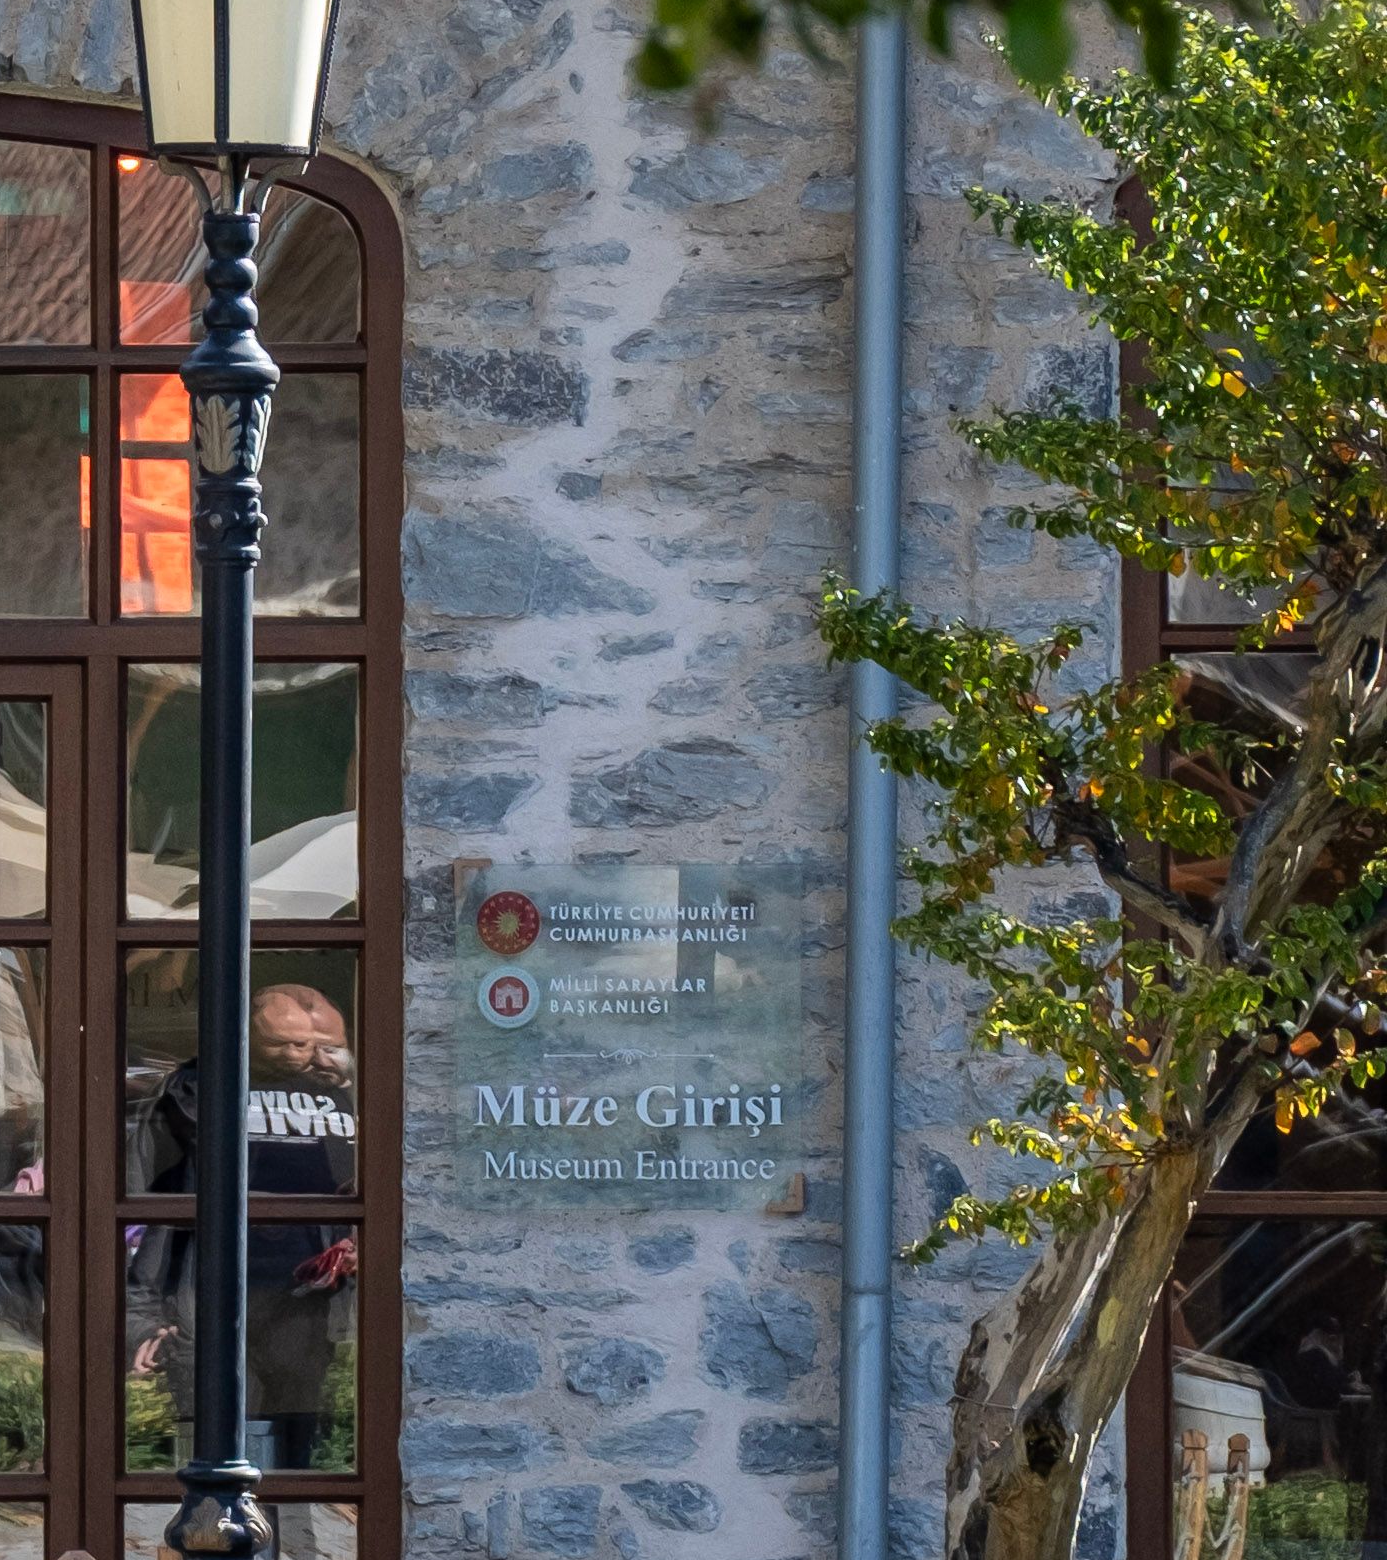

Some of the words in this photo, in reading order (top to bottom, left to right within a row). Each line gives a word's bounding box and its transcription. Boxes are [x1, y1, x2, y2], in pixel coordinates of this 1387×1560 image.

[550, 903, 624, 922] TÜRKİYE
[629, 902, 756, 922] CUMHURİYETİ
[549, 923, 747, 944] CUMHURBAŞKANLIĞI
[549, 975, 600, 993] MİLLİ
[605, 977, 707, 993] SARAYLAR
[549, 996, 670, 1017] BAŞKANLIĞI
[473, 1084, 619, 1128] Müze
[635, 1083, 785, 1138] Girişi
[483, 1149, 624, 1180] Museum
[634, 1149, 776, 1180] Entrance
